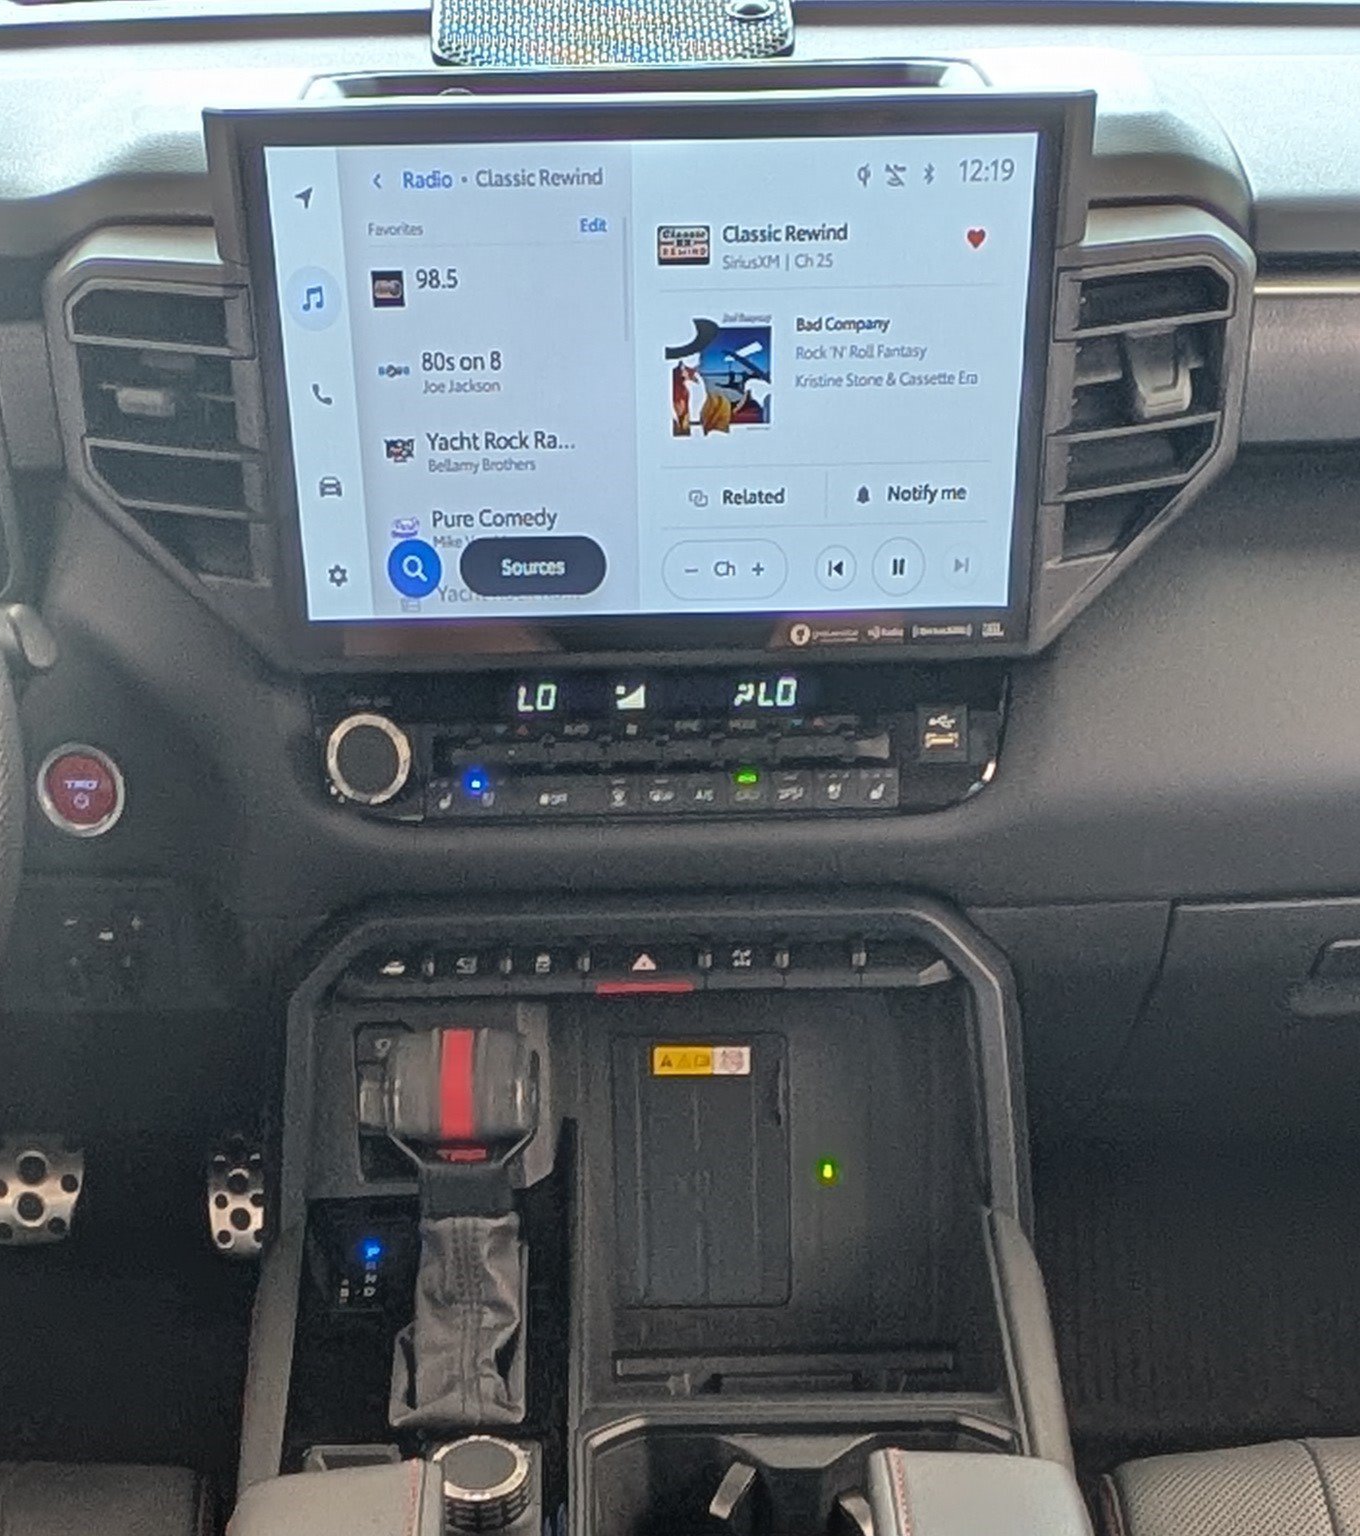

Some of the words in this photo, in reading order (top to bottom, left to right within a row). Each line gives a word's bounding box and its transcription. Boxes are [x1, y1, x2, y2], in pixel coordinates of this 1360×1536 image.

[403, 170, 453, 189] Radio
[475, 169, 536, 188] Classic
[539, 167, 603, 187] Rewind
[958, 158, 1015, 182] 12:19
[367, 222, 424, 236] Favorites
[579, 218, 608, 233] Edit
[722, 224, 782, 243] Classic
[785, 223, 848, 242] Rewind
[722, 254, 781, 270] SiriusXM
[794, 253, 814, 268] Ch
[816, 253, 833, 268] 25
[415, 268, 459, 290] 98.5
[796, 316, 822, 332] Bad
[825, 316, 890, 334] Company
[421, 351, 456, 372] 80s
[459, 354, 485, 371] on
[489, 350, 502, 371] 8
[795, 345, 827, 360] Rock
[849, 344, 874, 360] Roll
[876, 344, 928, 361] Fantasy
[423, 379, 445, 394] Joe
[448, 378, 501, 393] Jackson
[795, 373, 843, 388] Kristine
[845, 372, 884, 387] Stone
[886, 371, 897, 386] &
[899, 370, 955, 386] Cassette
[958, 370, 978, 385] Era
[425, 431, 480, 451] Yacht
[484, 431, 529, 450] Rock
[534, 431, 576, 449] Ra...
[427, 458, 480, 474] Bellamy
[482, 458, 537, 472] Brothers
[722, 487, 786, 505] Related
[887, 484, 937, 504] Notify
[941, 486, 967, 500] me
[432, 509, 475, 528] Pure
[478, 507, 558, 531] Comedy
[501, 558, 566, 577] Sources
[713, 560, 736, 577] Ch
[517, 683, 557, 712] LO
[757, 677, 798, 707] LO
